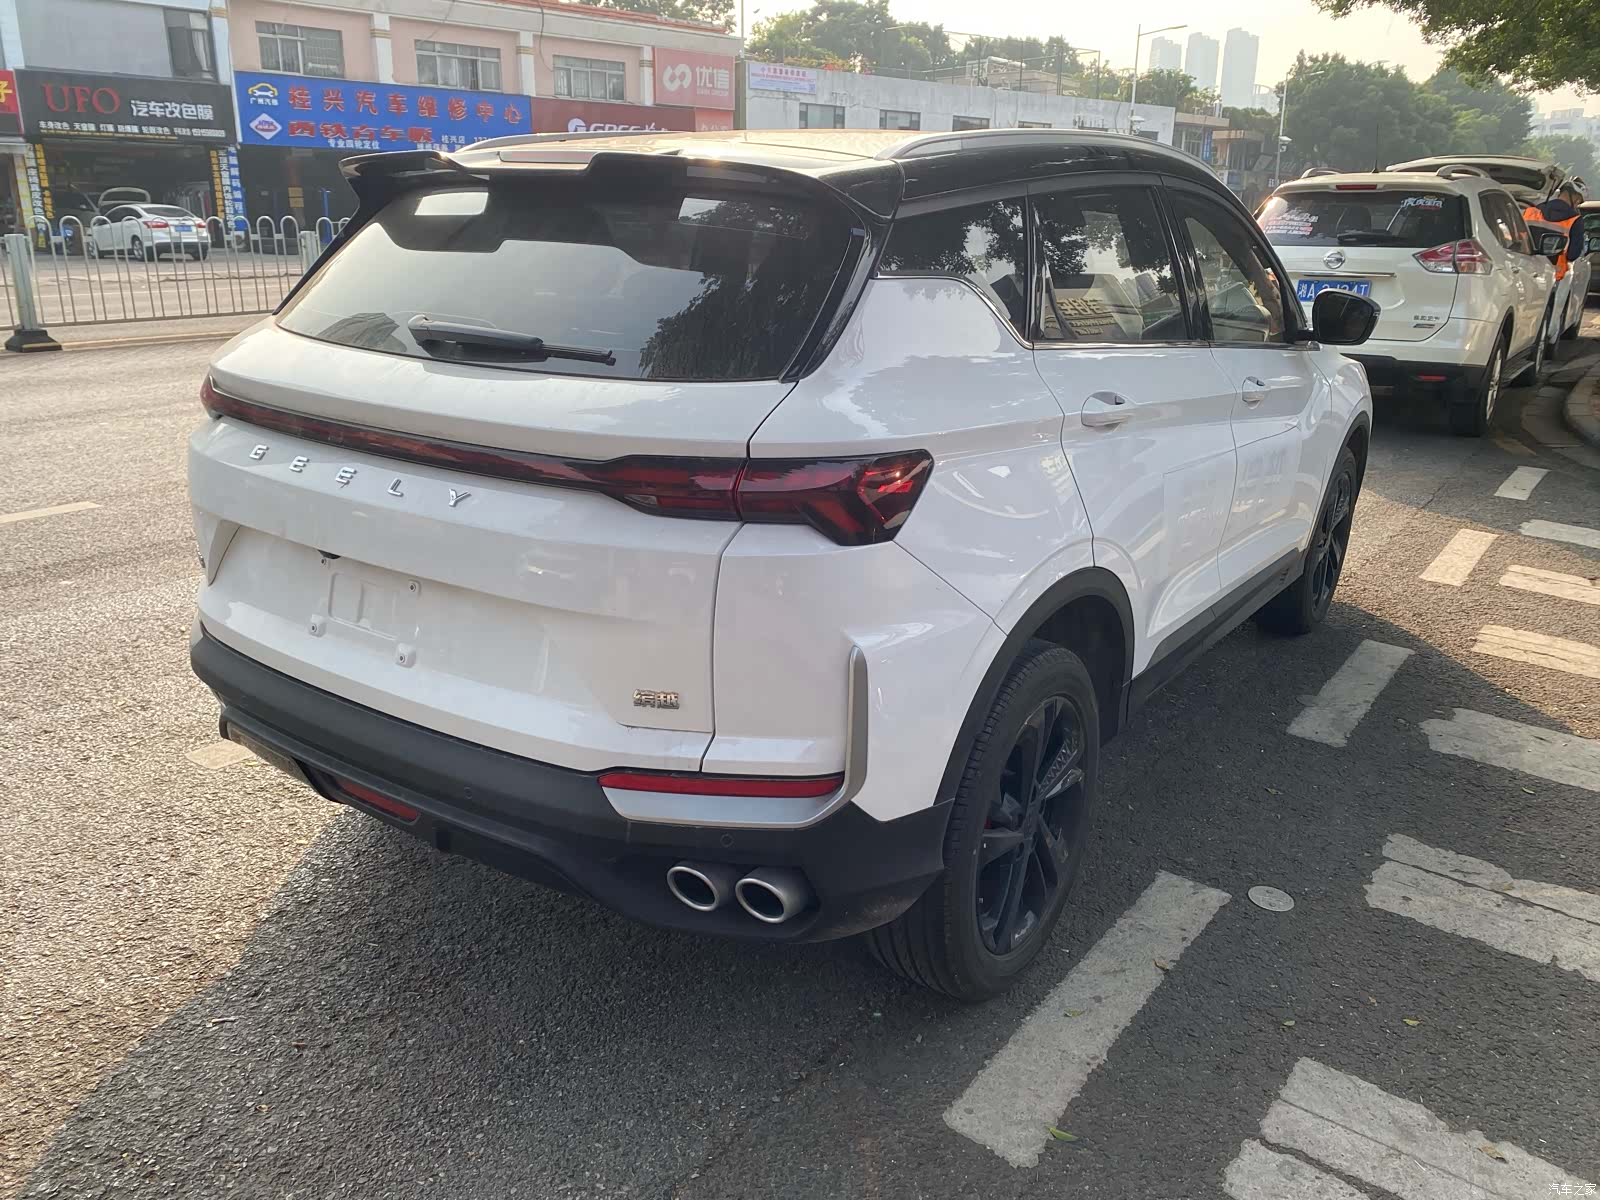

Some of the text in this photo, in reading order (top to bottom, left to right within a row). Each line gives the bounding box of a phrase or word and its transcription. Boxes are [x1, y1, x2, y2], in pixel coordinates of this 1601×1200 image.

[696, 66, 730, 88] 优信
[43, 84, 120, 114] UFO
[131, 100, 214, 121] 汽车改色膜
[250, 444, 471, 507] GEELY
